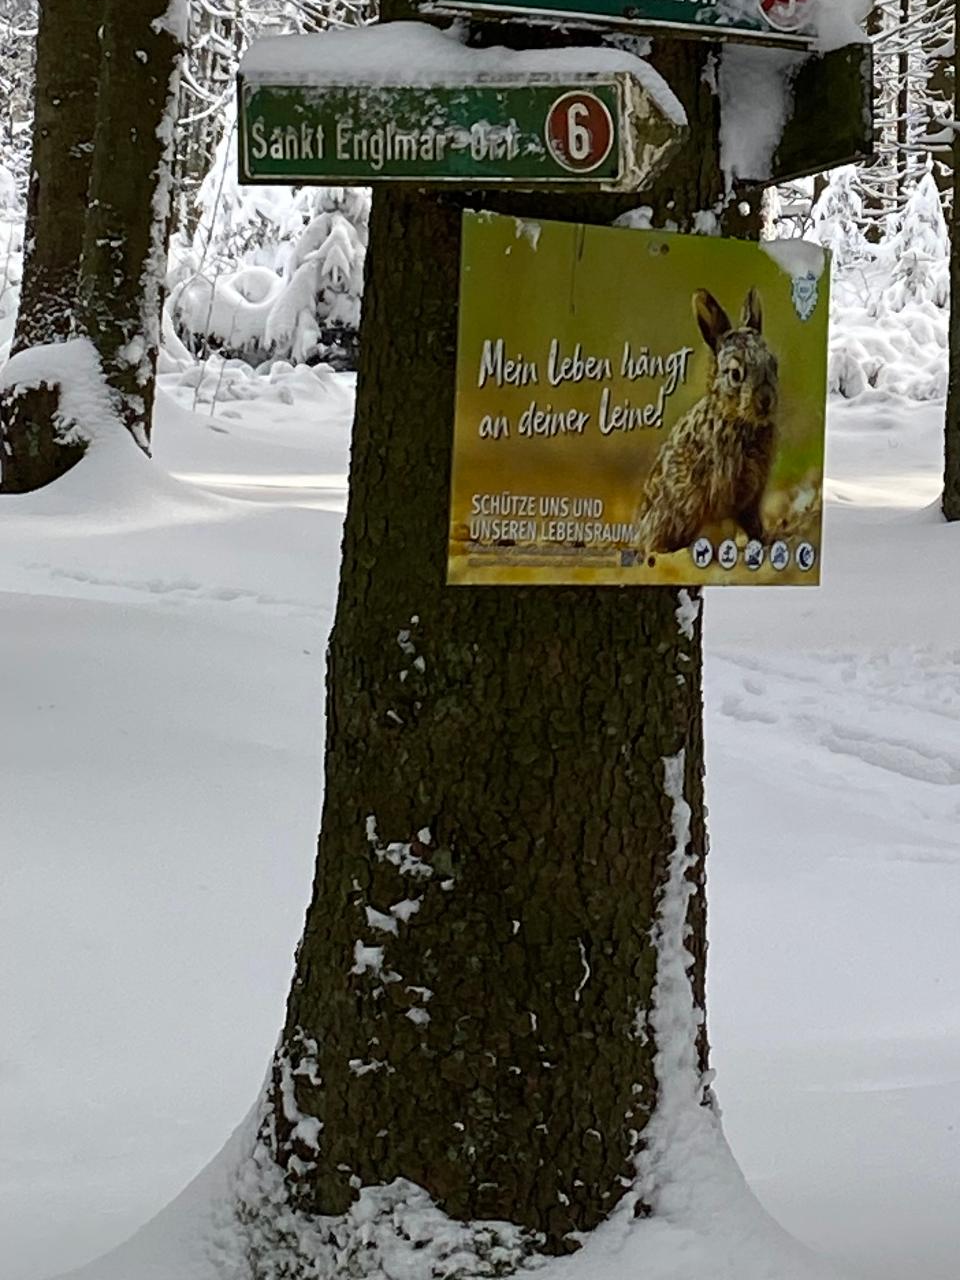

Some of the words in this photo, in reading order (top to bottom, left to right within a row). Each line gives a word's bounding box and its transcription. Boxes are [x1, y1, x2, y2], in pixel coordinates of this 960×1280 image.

[252, 121, 325, 160] Sankt
[567, 102, 590, 160] 6
[478, 338, 538, 389] Mein
[621, 341, 694, 396] hängt
[479, 413, 509, 439] an
[519, 400, 590, 438] deiner
[471, 491, 536, 517] SCHÜTZE
[539, 496, 569, 518] UNS
[573, 498, 604, 519] UND
[470, 520, 537, 541] UNSEREN
